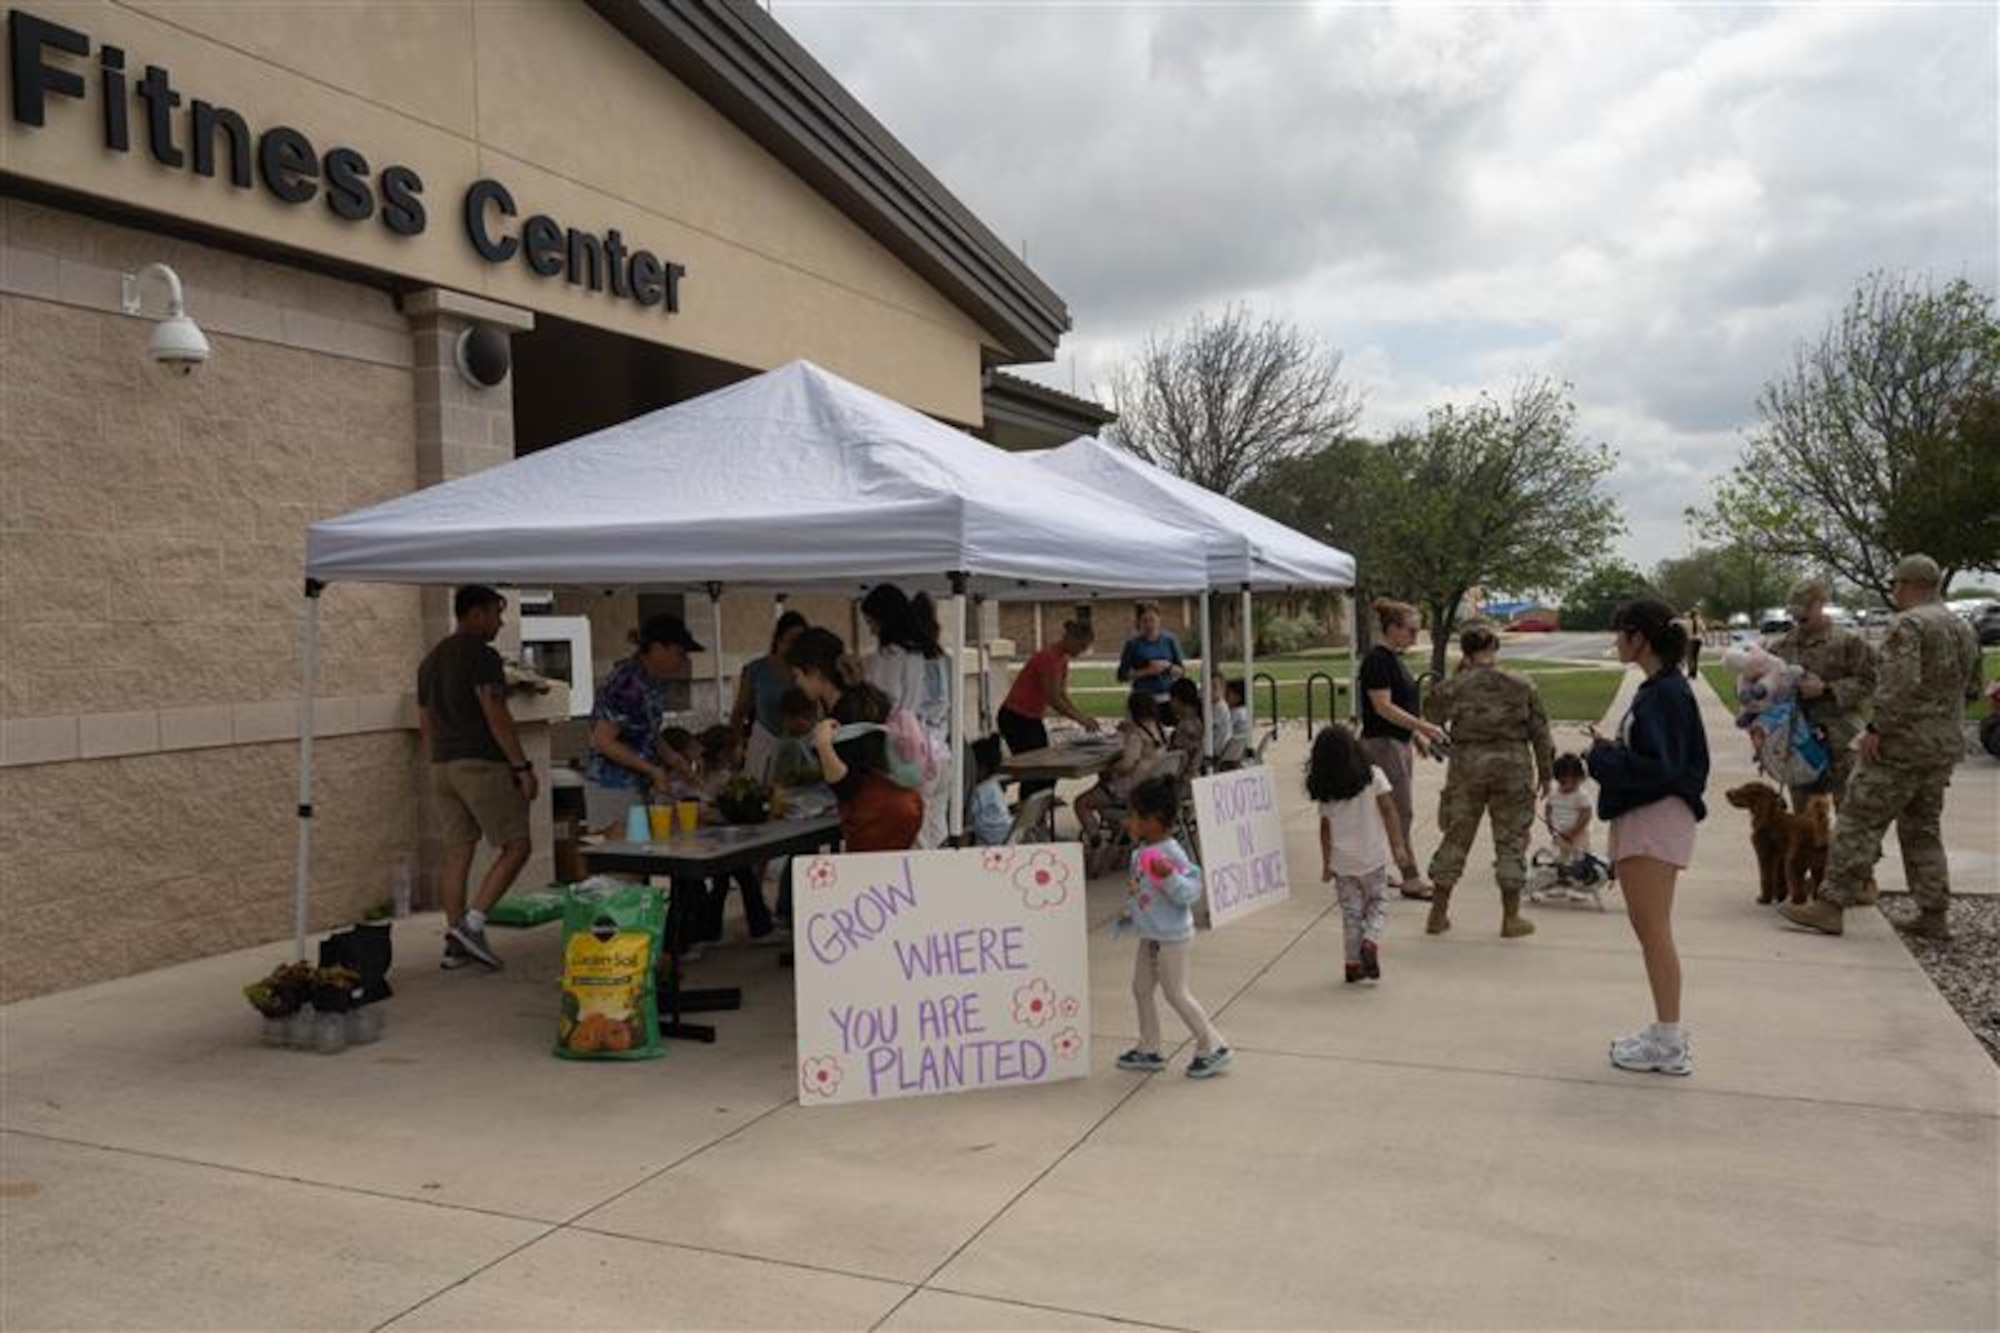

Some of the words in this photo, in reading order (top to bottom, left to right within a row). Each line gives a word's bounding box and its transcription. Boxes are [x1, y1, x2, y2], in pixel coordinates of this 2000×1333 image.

[10, 9, 427, 237] Fitness
[464, 178, 686, 313] Center
[1212, 775, 1271, 825] ROOTED
[1238, 820, 1254, 858] IN
[807, 857, 917, 965] GROW
[1212, 850, 1287, 914] RESILIENCE
[893, 926, 1029, 981] WHERE
[829, 1004, 899, 1054] YOU
[918, 993, 987, 1041] ARE
[867, 1039, 1047, 1096] PLANTED
